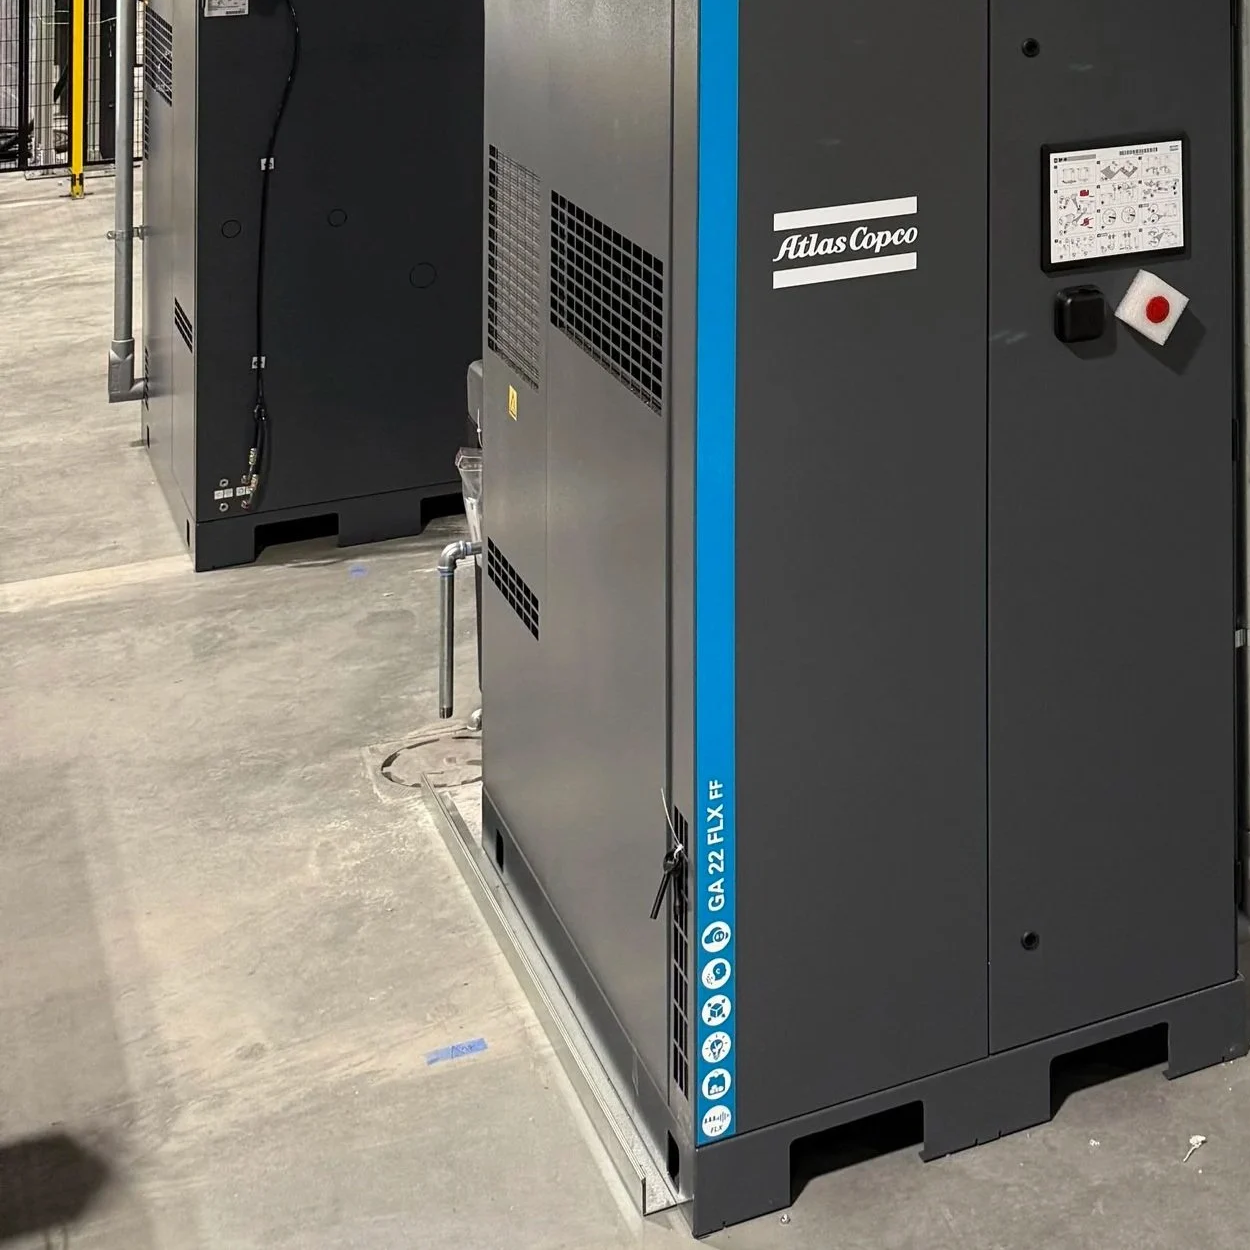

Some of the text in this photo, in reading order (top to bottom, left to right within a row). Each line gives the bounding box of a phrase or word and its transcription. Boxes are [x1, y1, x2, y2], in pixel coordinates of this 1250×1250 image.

[772, 226, 918, 262] Atlas Copco
[706, 779, 725, 912] GA 22 FLX FF
[710, 1125, 723, 1134] FLX
